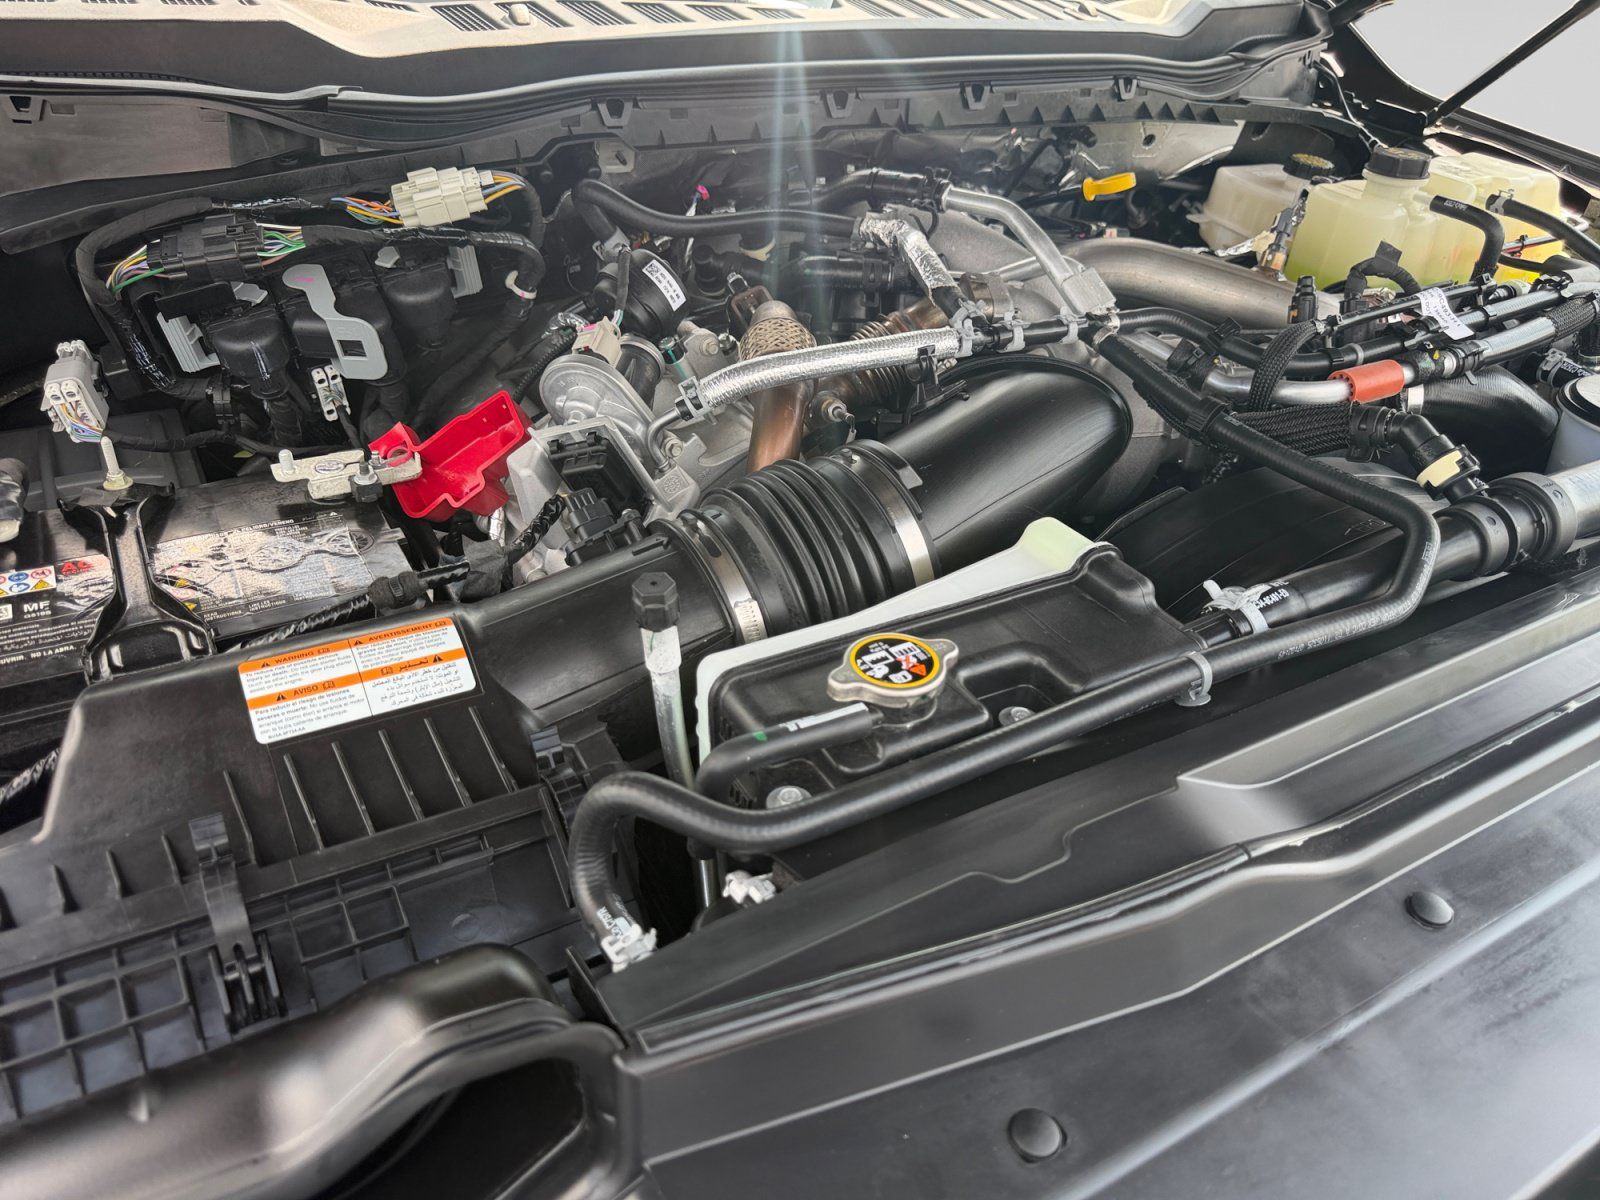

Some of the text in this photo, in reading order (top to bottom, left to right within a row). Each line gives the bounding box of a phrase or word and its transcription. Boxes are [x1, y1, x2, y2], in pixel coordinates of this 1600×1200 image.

[23, 600, 51, 613] MF
[368, 624, 433, 642] AVERTISSEMENT
[43, 649, 54, 657] LA
[275, 652, 315, 664] WARNING
[293, 686, 319, 696] AVISO
